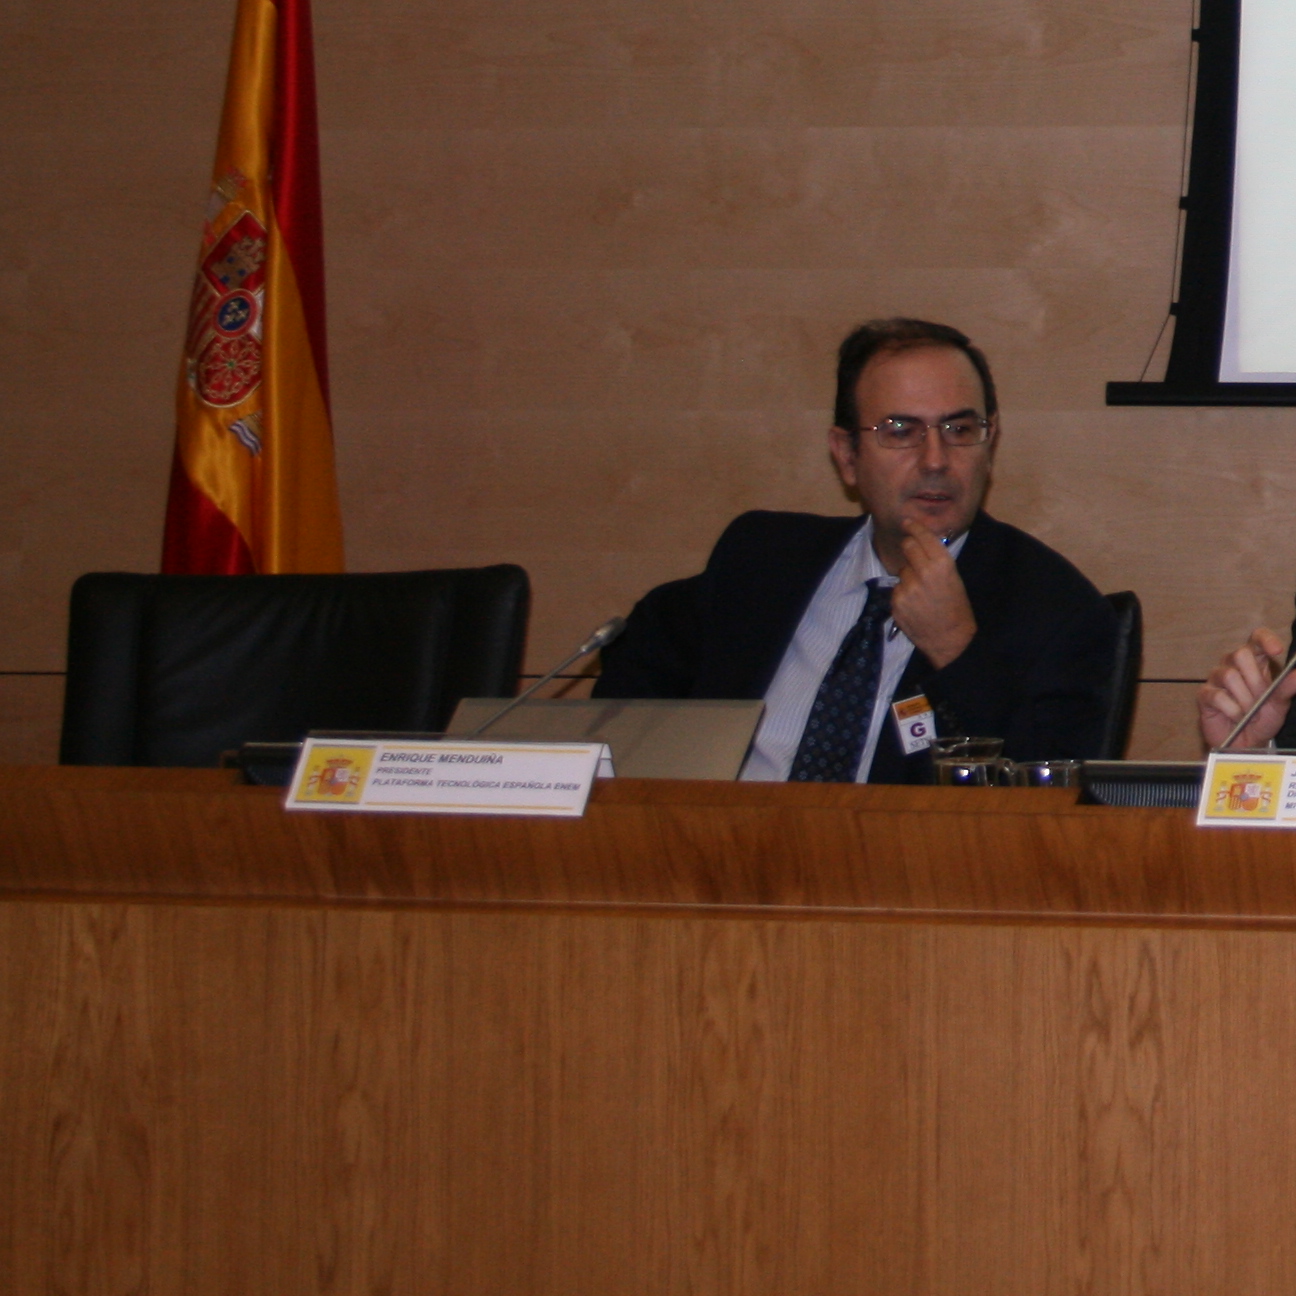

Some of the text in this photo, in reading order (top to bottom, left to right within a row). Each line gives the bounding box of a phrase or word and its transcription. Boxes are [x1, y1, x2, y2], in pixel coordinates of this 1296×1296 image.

[910, 722, 927, 737] G
[380, 752, 503, 765] ENRIQUE MENDUIÑA
[375, 767, 432, 776] PRESIDENTE
